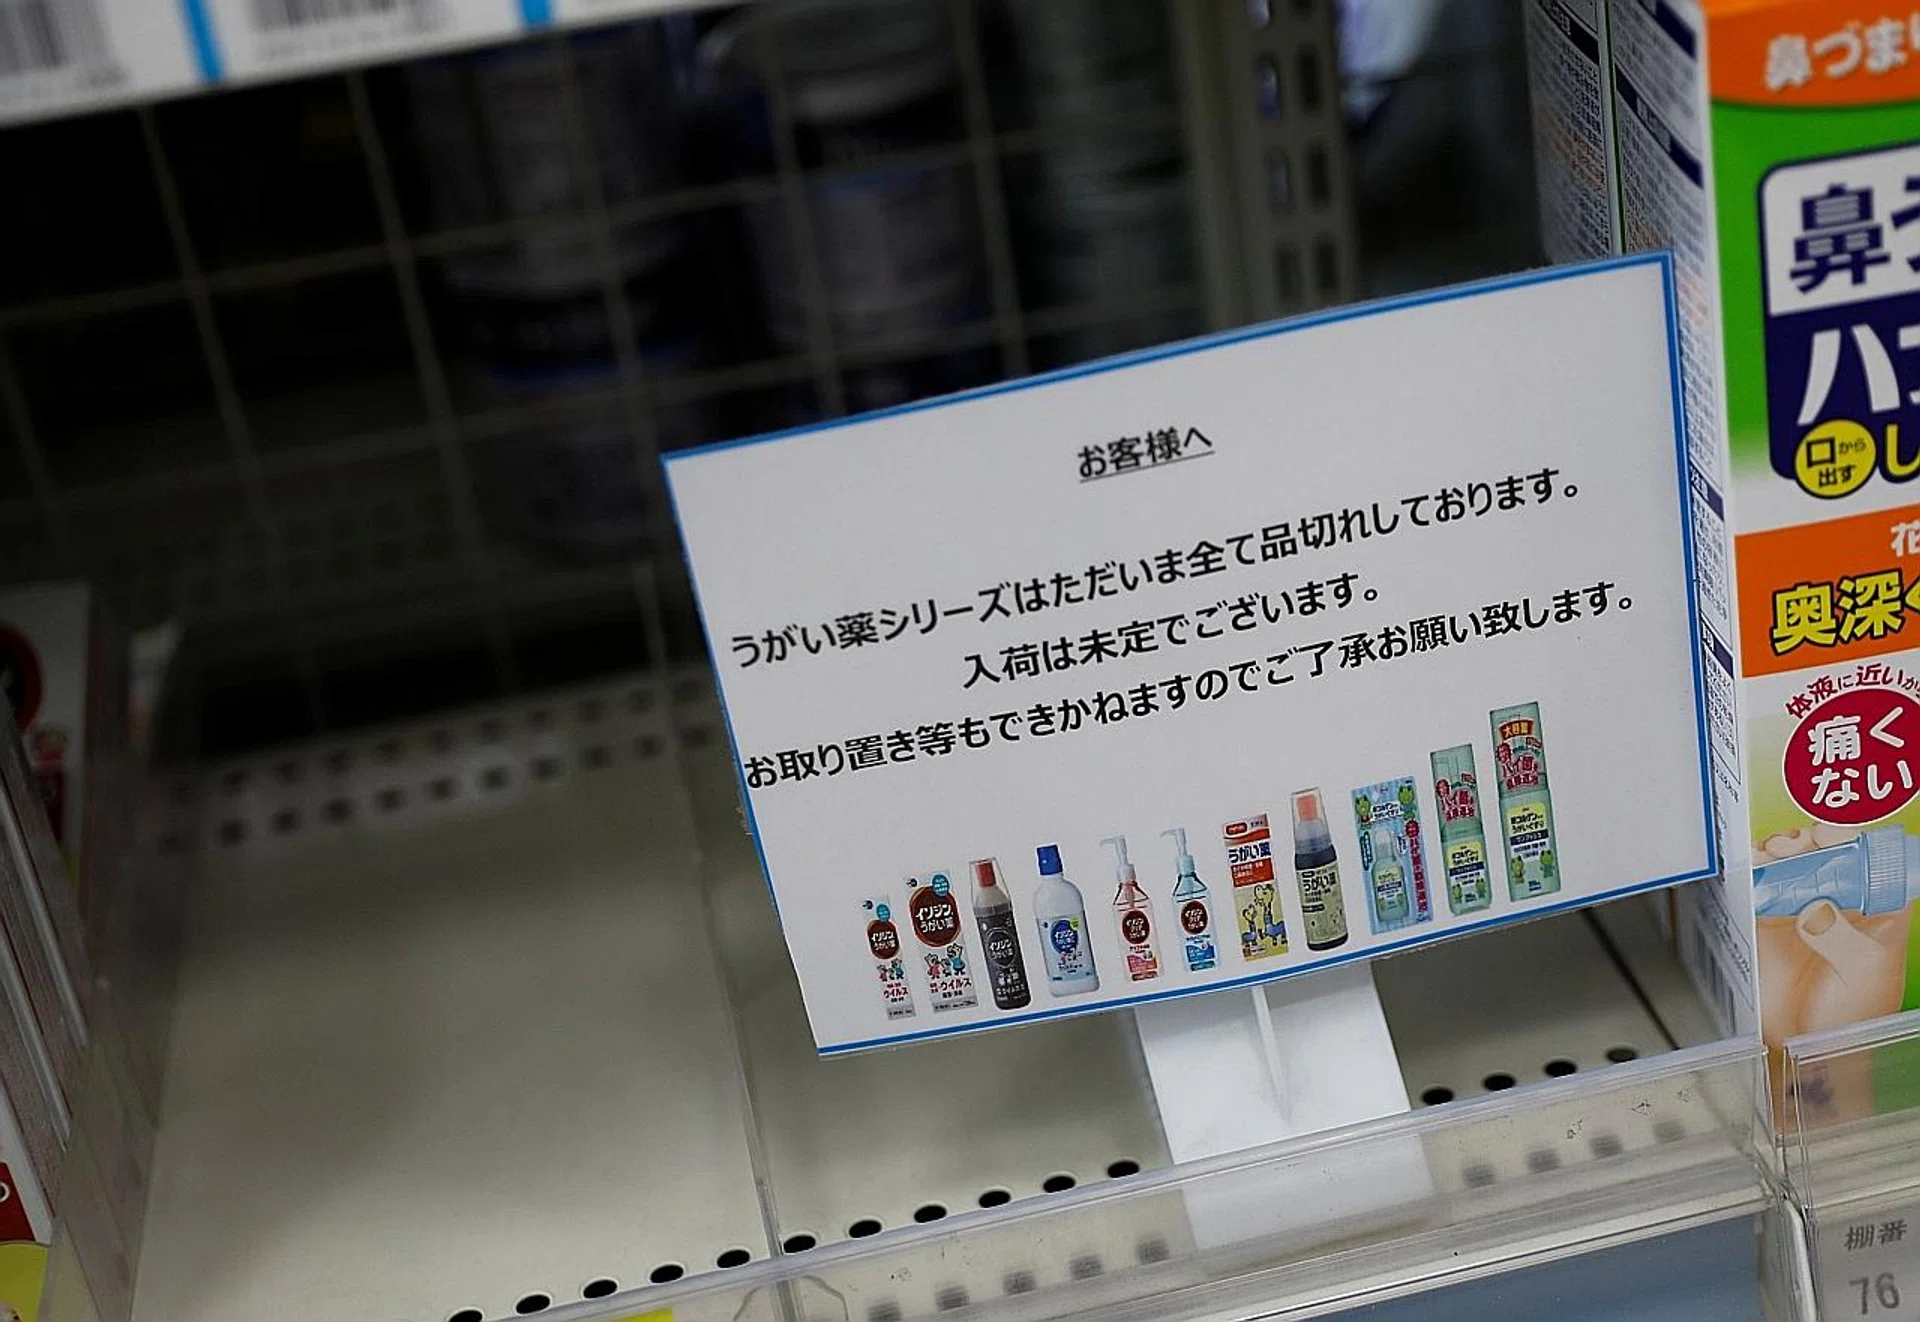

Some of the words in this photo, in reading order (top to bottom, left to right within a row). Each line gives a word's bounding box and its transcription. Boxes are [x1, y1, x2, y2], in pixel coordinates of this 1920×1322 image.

[1077, 425, 1215, 480] お客様へ
[1818, 464, 1857, 488] 出す
[731, 468, 1579, 668] うがい薬シリーズはただいま全て品切れしております。
[963, 573, 1379, 689] 入荷は未定でございます。
[745, 581, 1634, 789] お取り置き等もできかねますのでご了承お願い致します。
[1785, 662, 1920, 719] 体液に近いか
[1808, 706, 1905, 766] 痛く
[1811, 760, 1914, 808] ない
[1848, 1271, 1901, 1315] 76
